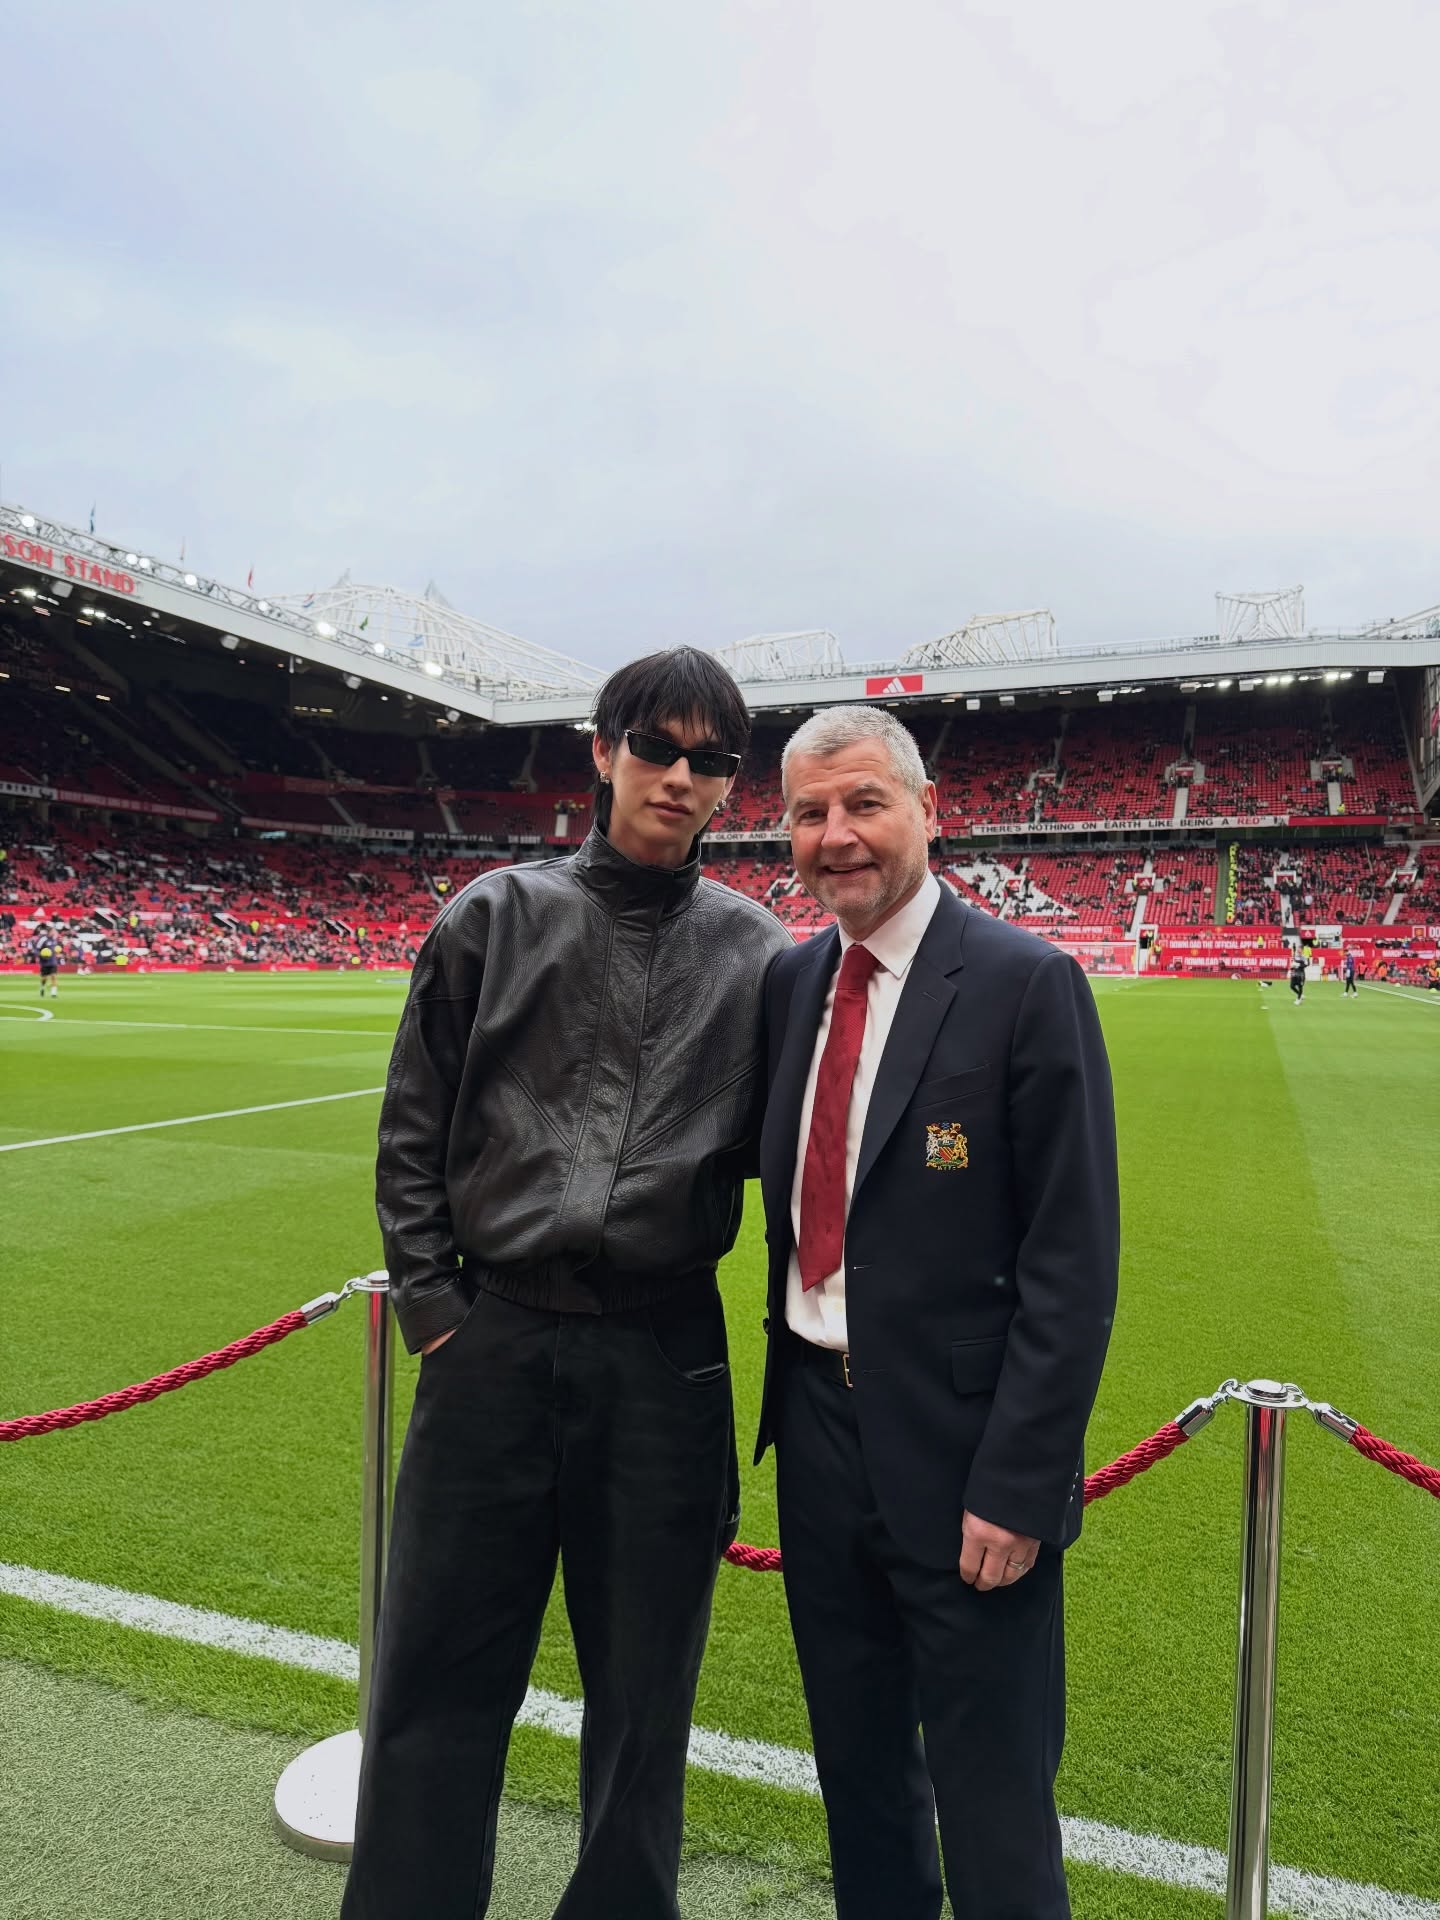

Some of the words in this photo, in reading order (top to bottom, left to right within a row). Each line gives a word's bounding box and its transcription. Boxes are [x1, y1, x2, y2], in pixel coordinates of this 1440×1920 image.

[0, 532, 53, 569] SON
[63, 554, 135, 593] STAND
[1028, 823, 1075, 831] NOTHING
[1082, 822, 1097, 830] ON
[1104, 820, 1142, 829] EARTH
[1148, 819, 1174, 828] LIKE
[1180, 818, 1214, 827] BEING
[1221, 818, 1230, 826] A
[478, 834, 494, 843] ALL
[715, 832, 744, 841] GLORY
[749, 831, 767, 840] AND
[1170, 940, 1201, 949] DOWNLOAD
[1203, 940, 1213, 949] THE
[1215, 940, 1238, 949] OFFICIAL
[1240, 940, 1252, 949] APP
[1184, 956, 1218, 966] DOWNLOAD
[1232, 957, 1257, 967] OFFICIAL
[1260, 957, 1273, 967] APP
[1273, 957, 1288, 968] NOW
